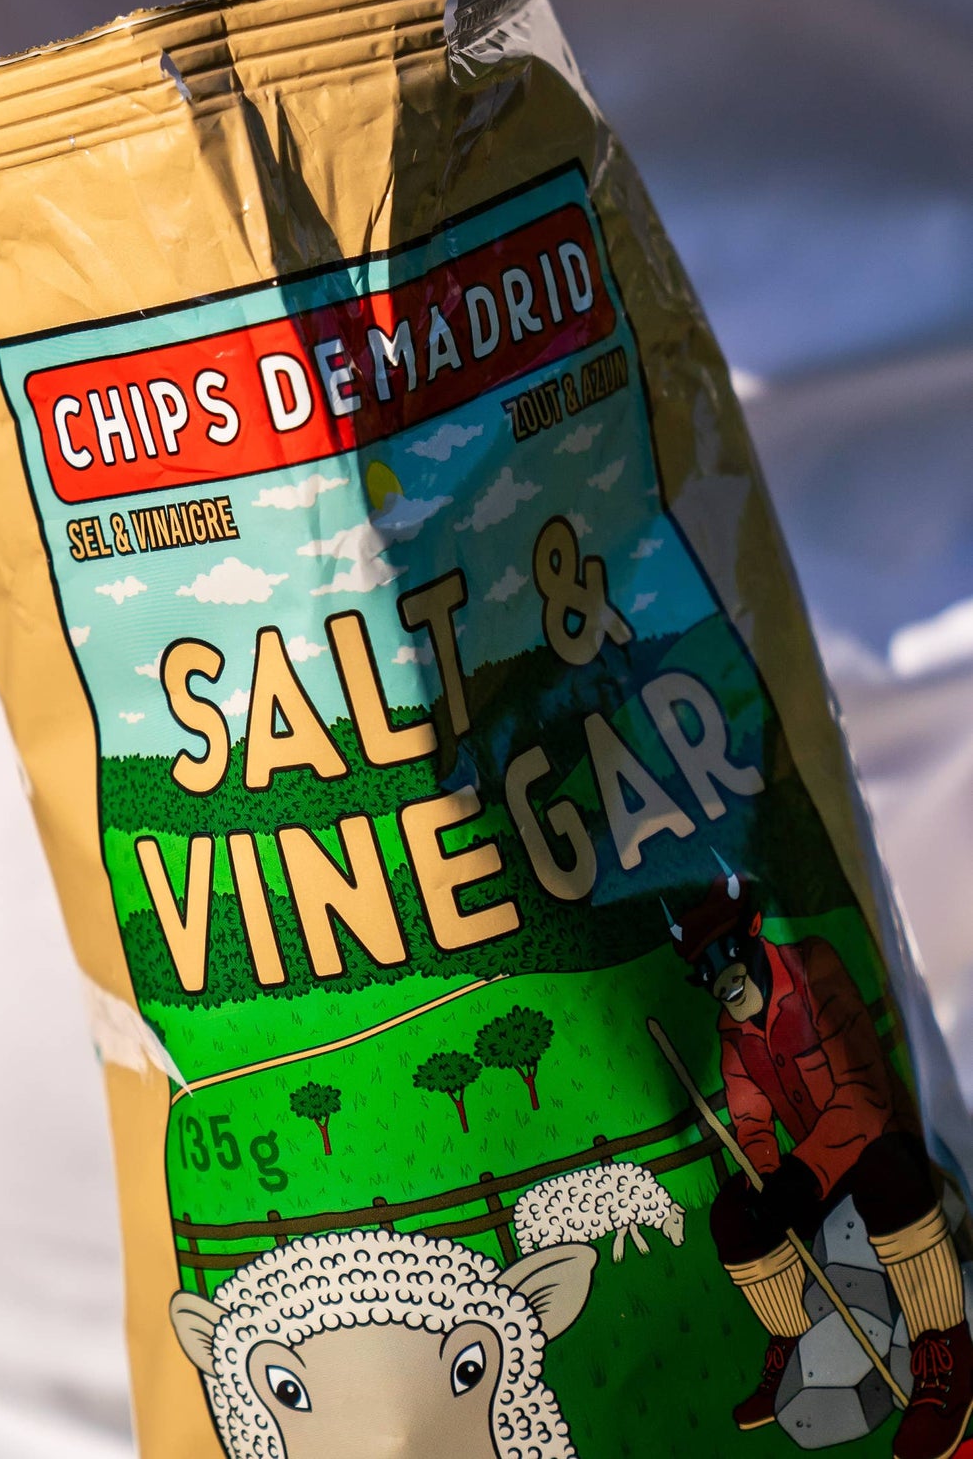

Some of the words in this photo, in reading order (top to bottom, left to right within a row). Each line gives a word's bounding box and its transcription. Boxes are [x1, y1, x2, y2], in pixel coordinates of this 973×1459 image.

[52, 367, 240, 470] CHIPS
[259, 337, 363, 434] DE
[366, 241, 595, 401] MADRID
[502, 380, 562, 442] ZOUT
[562, 373, 581, 416] &
[67, 516, 114, 561] SEL
[110, 513, 135, 555] &
[129, 496, 239, 553] VINAIGRE
[159, 569, 473, 797] SALT
[534, 515, 634, 666] &
[133, 668, 765, 994] VINEGAR
[179, 1113, 242, 1172] 135
[249, 1130, 289, 1193] g
